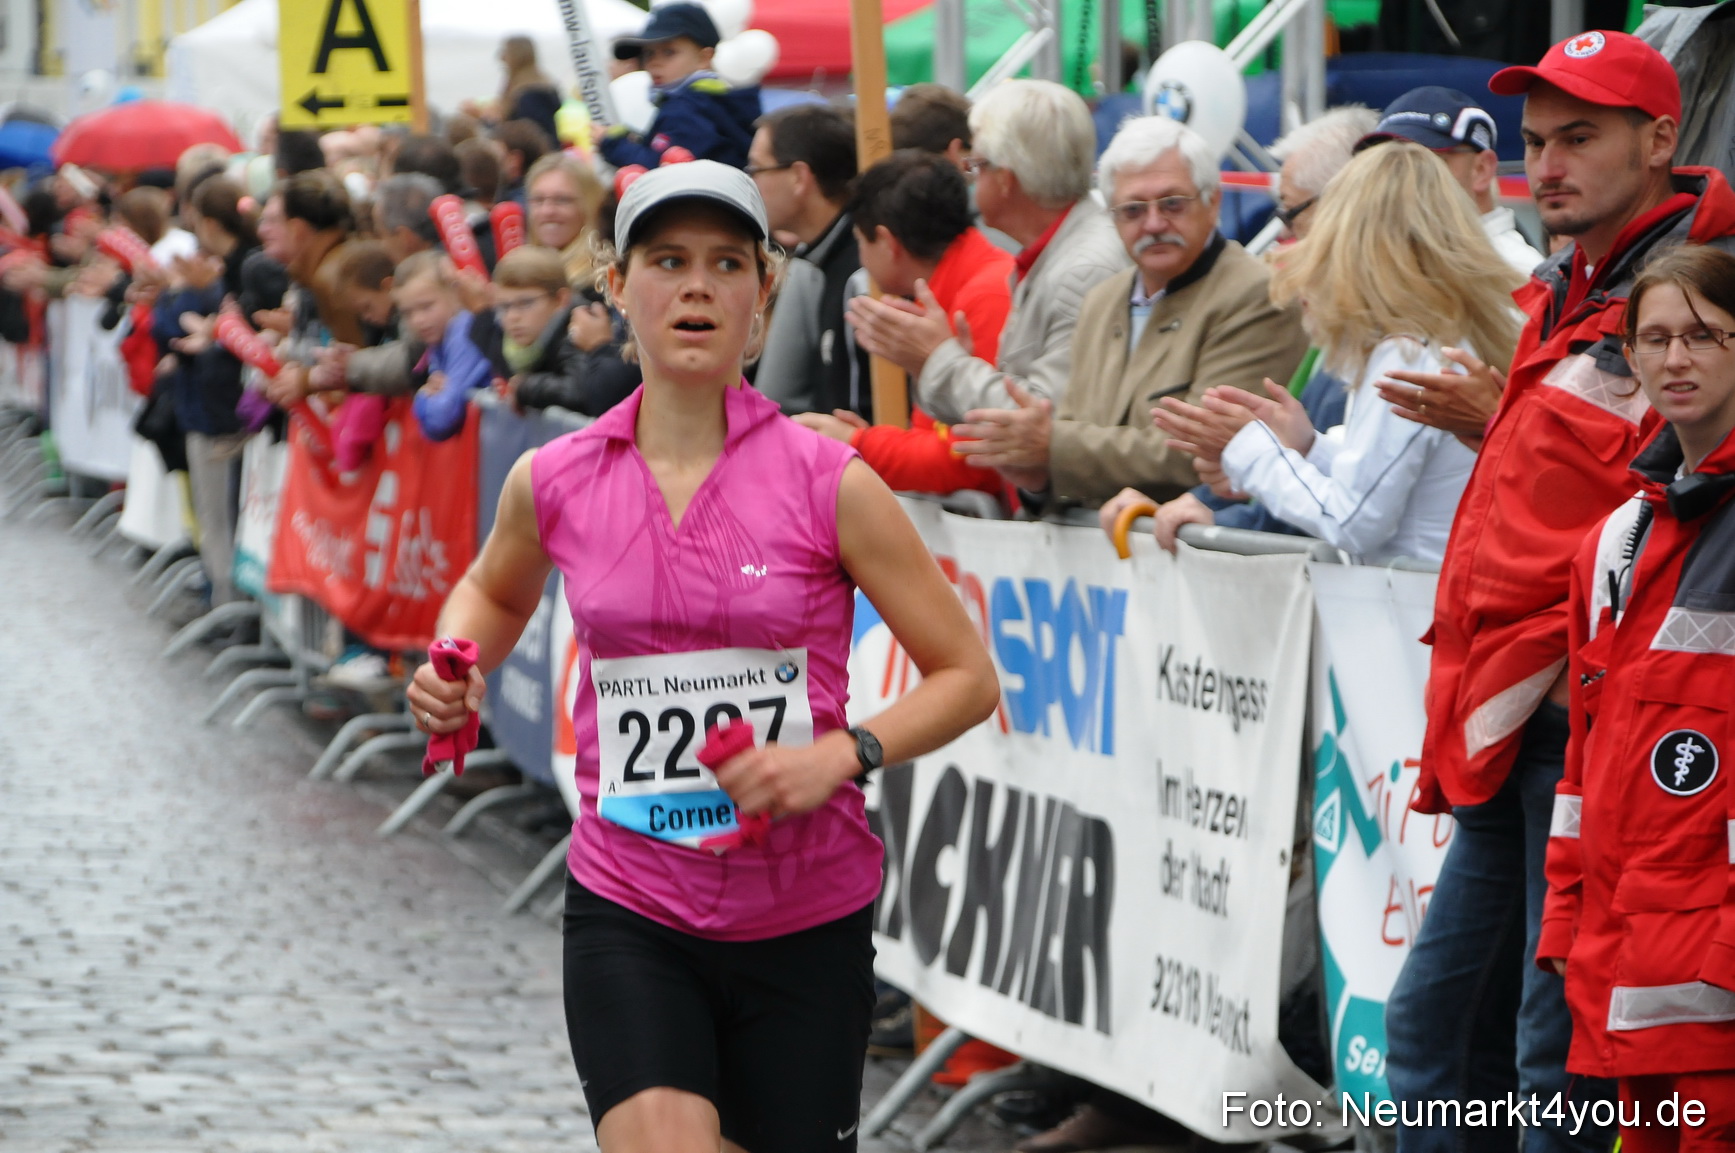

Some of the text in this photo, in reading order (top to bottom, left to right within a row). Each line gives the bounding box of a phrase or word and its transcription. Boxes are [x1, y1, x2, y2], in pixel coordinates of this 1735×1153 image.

[310, 0, 393, 74] A
[599, 668, 767, 698] PARTL Neumarkt
[607, 782, 617, 794] A
[649, 802, 739, 832] Corne
